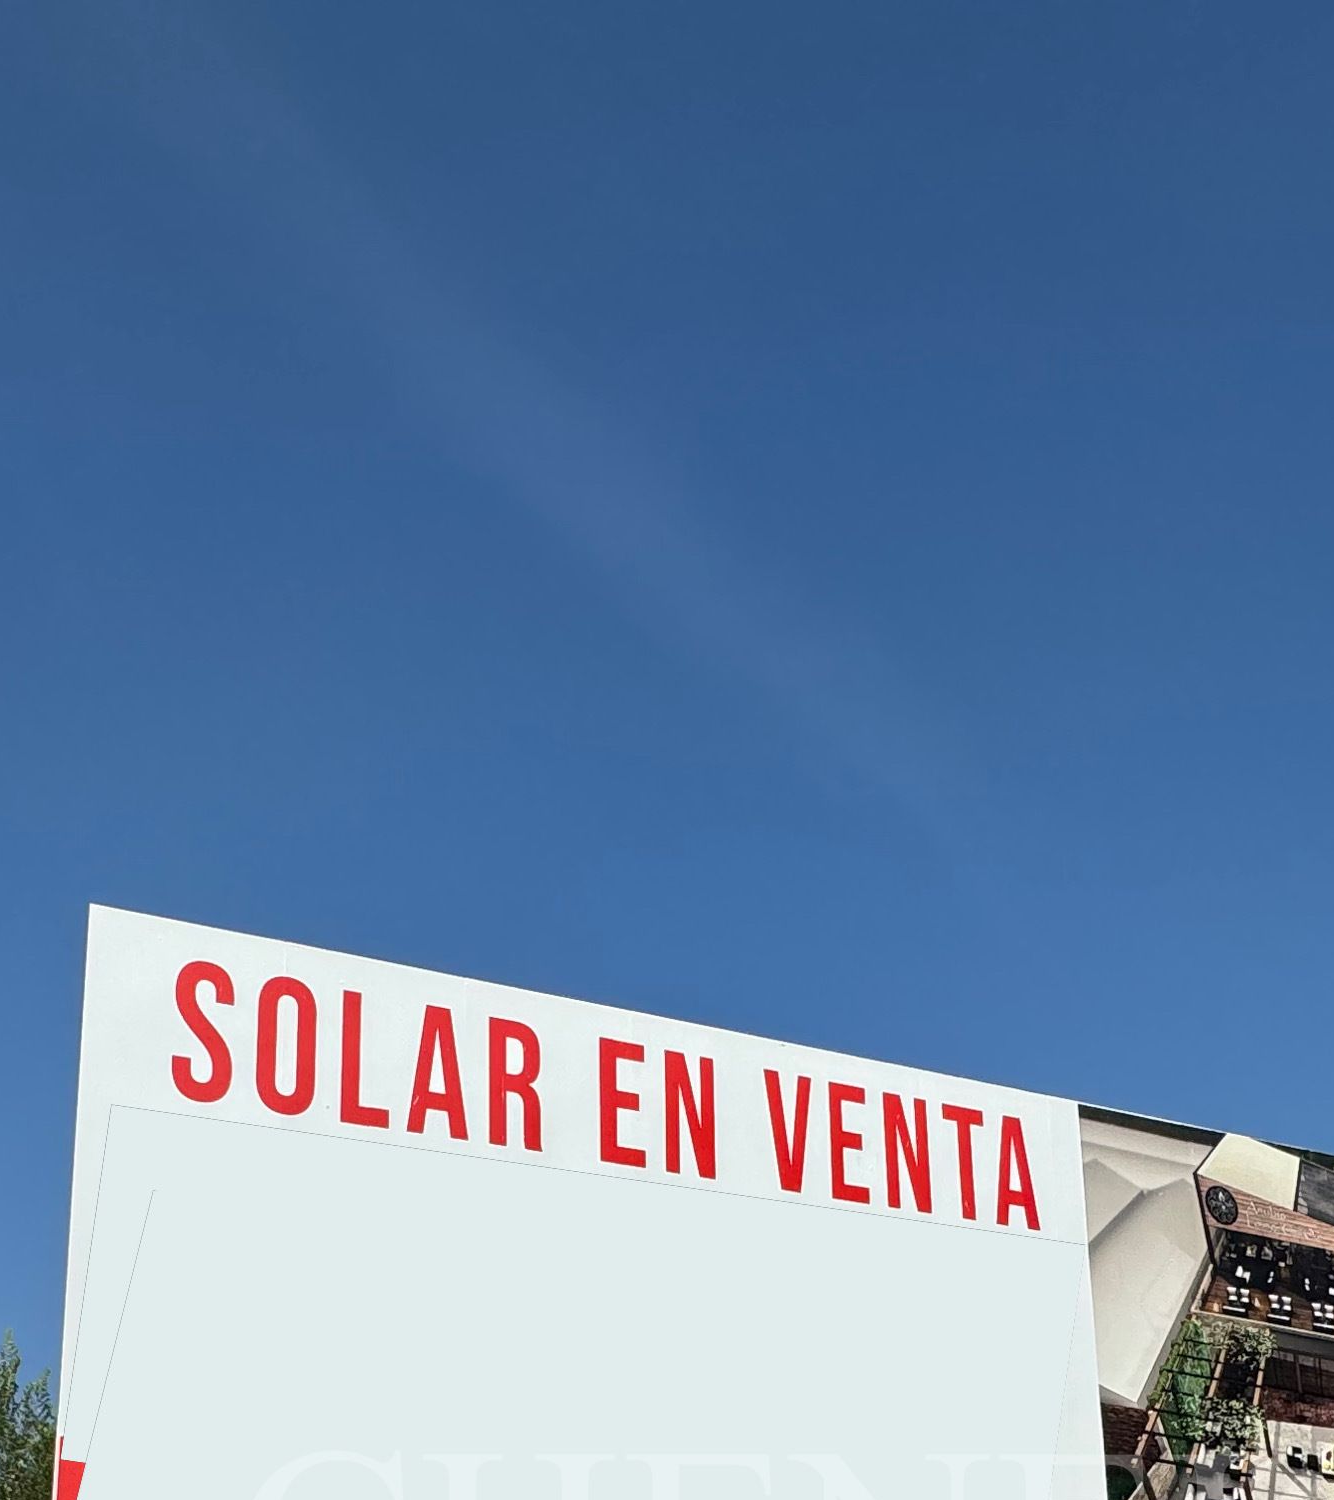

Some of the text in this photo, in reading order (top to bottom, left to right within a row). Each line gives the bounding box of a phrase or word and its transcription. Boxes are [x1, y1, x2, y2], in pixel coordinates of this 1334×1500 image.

[170, 959, 1042, 1231] SOLAR EN VENTA
